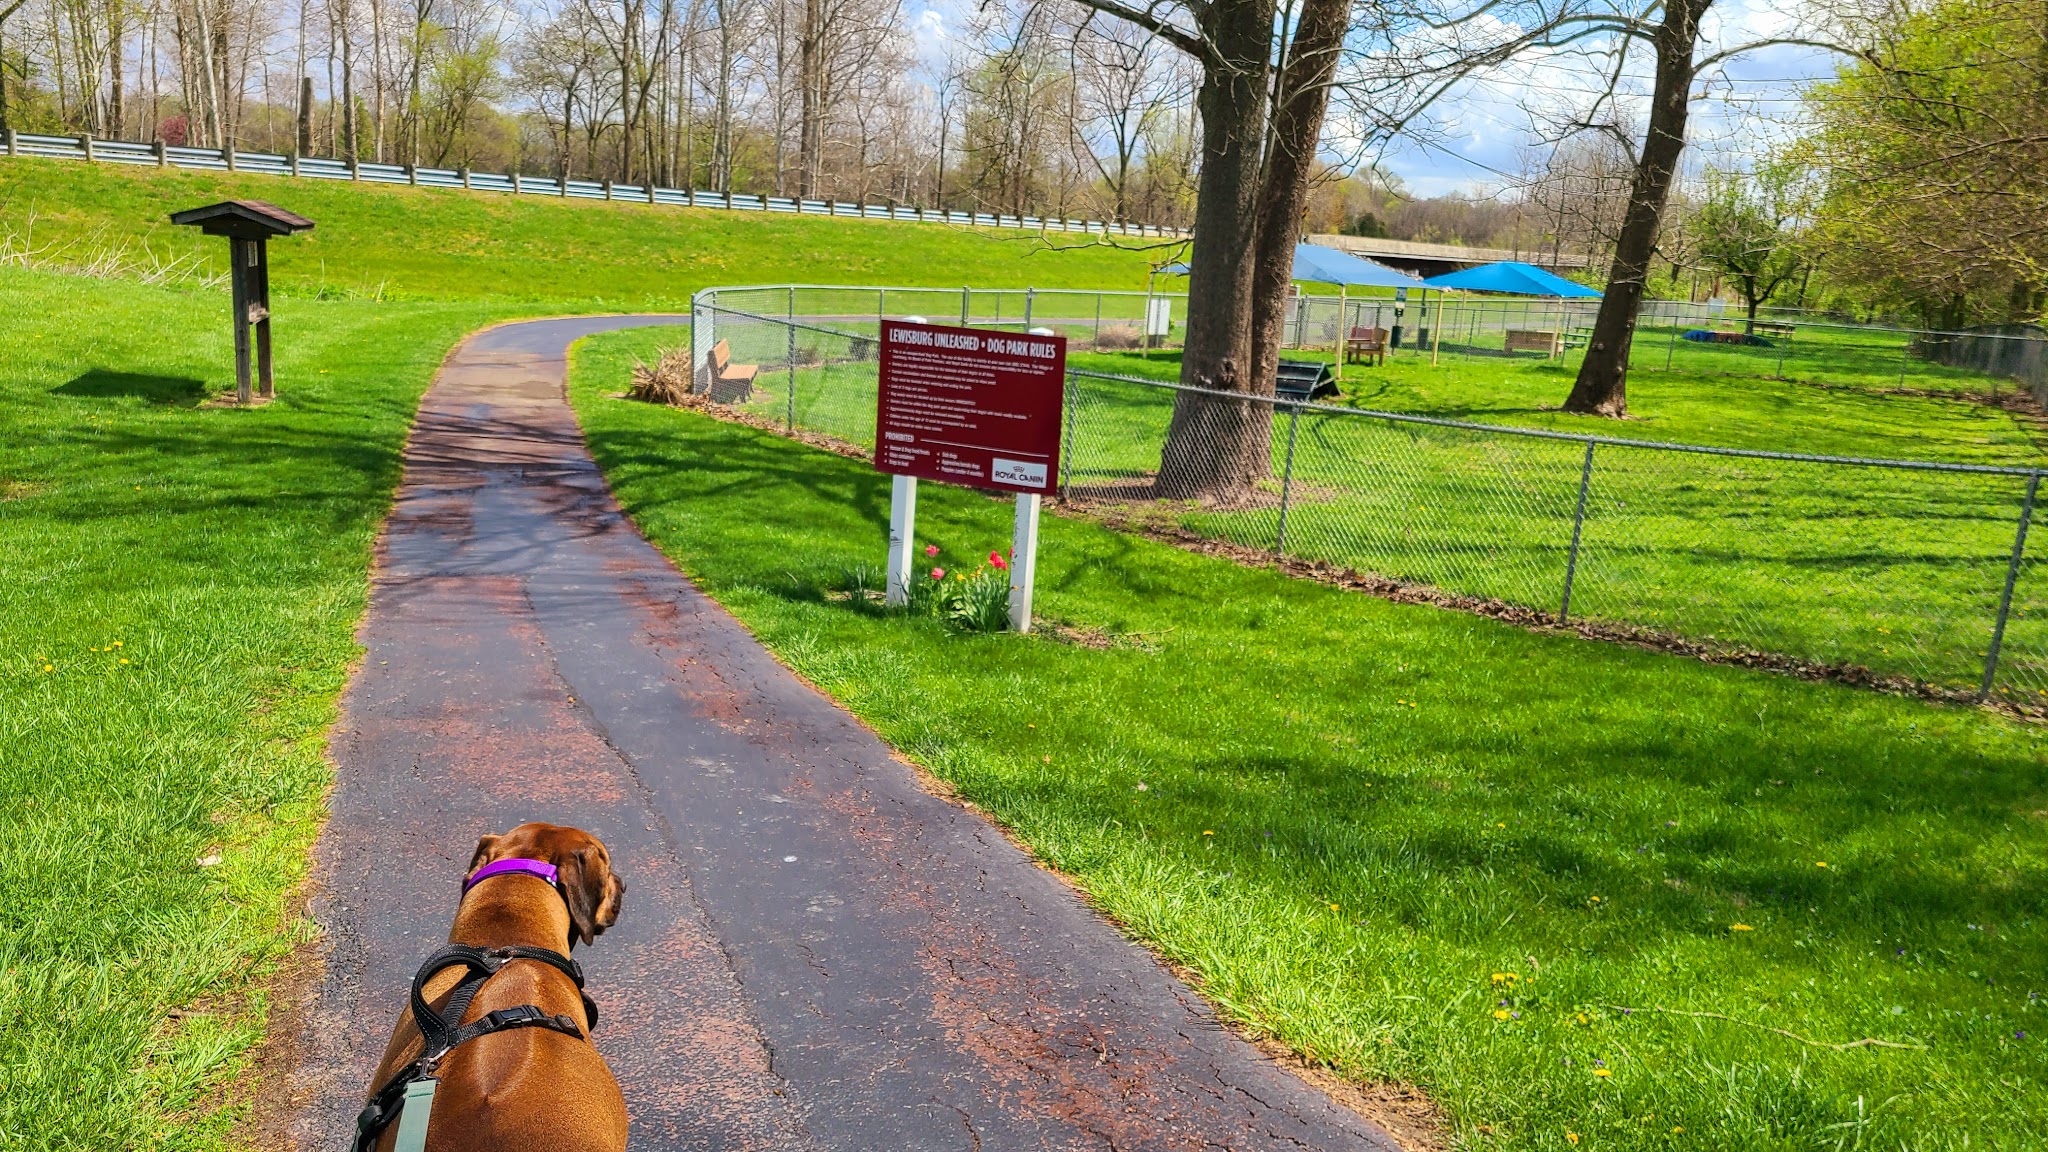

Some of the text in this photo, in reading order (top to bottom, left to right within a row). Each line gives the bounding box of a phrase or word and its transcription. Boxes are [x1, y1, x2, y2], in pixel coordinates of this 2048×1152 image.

[889, 328, 1056, 359] LEWISBURG UNLEASHED DOG PARK RULES
[885, 431, 915, 443] PROHIBITED
[995, 470, 1017, 480] ROYAL
[1019, 474, 1044, 484] CANIN
